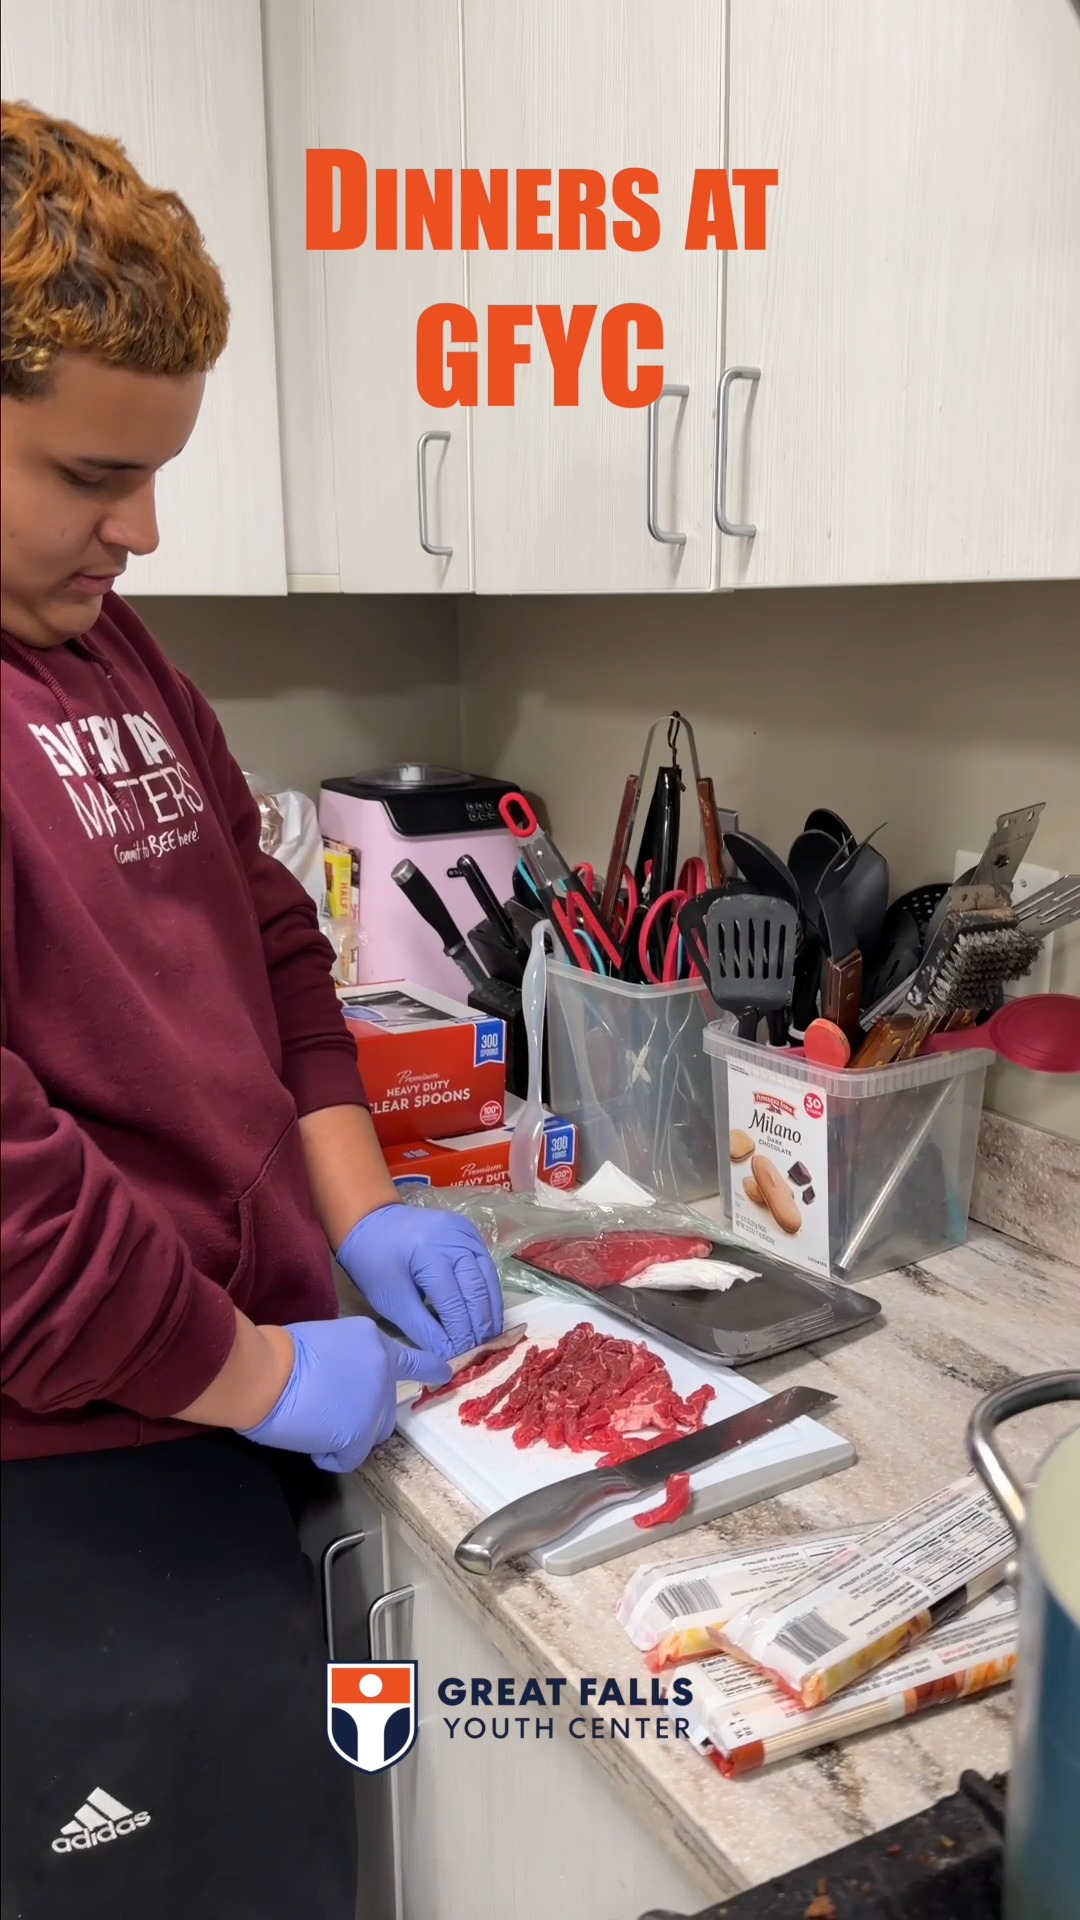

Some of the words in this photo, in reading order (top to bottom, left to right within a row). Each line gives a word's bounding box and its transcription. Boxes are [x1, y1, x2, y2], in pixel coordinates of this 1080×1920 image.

[62, 761, 204, 840] MATTERS
[141, 839, 150, 860] to
[147, 829, 176, 858] BEE
[176, 820, 200, 847] here!
[481, 1033, 499, 1049] 300
[396, 1069, 440, 1084] Premium
[386, 1083, 420, 1098] HEAVY
[422, 1079, 450, 1092] DUTY
[414, 1088, 471, 1108] SPOONS
[805, 1095, 822, 1110] 30
[748, 1108, 802, 1144] Milano
[551, 1135, 568, 1152] 300
[758, 1138, 792, 1157] CHOCOLATE
[766, 1135, 783, 1147] DARK
[460, 1162, 504, 1178] Premium
[51, 1811, 152, 1853] adidas
